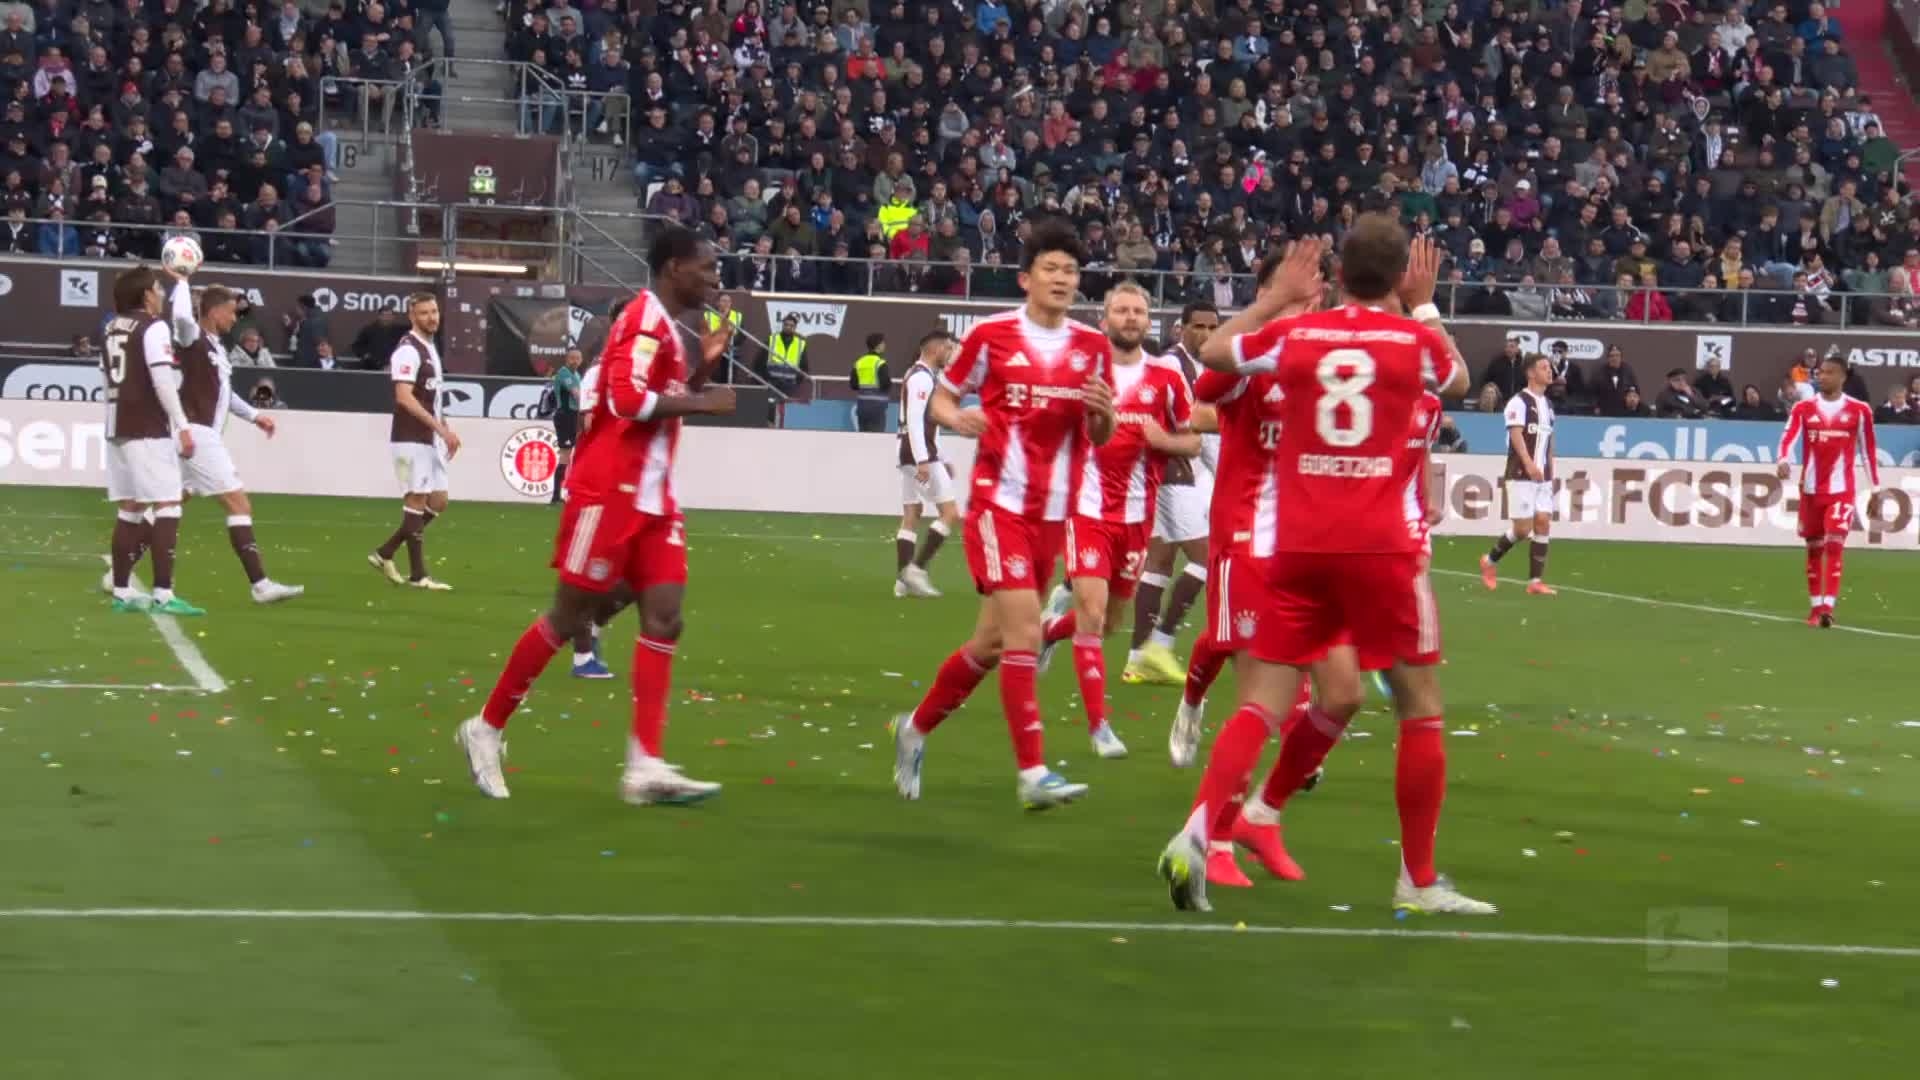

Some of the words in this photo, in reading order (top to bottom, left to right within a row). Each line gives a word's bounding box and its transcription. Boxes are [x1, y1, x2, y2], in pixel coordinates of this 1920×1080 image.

[592, 157, 619, 181] H7
[343, 290, 413, 313] smar
[1316, 348, 1376, 447] 8
[521, 481, 548, 492] 1910
[1831, 501, 1854, 521] 17
